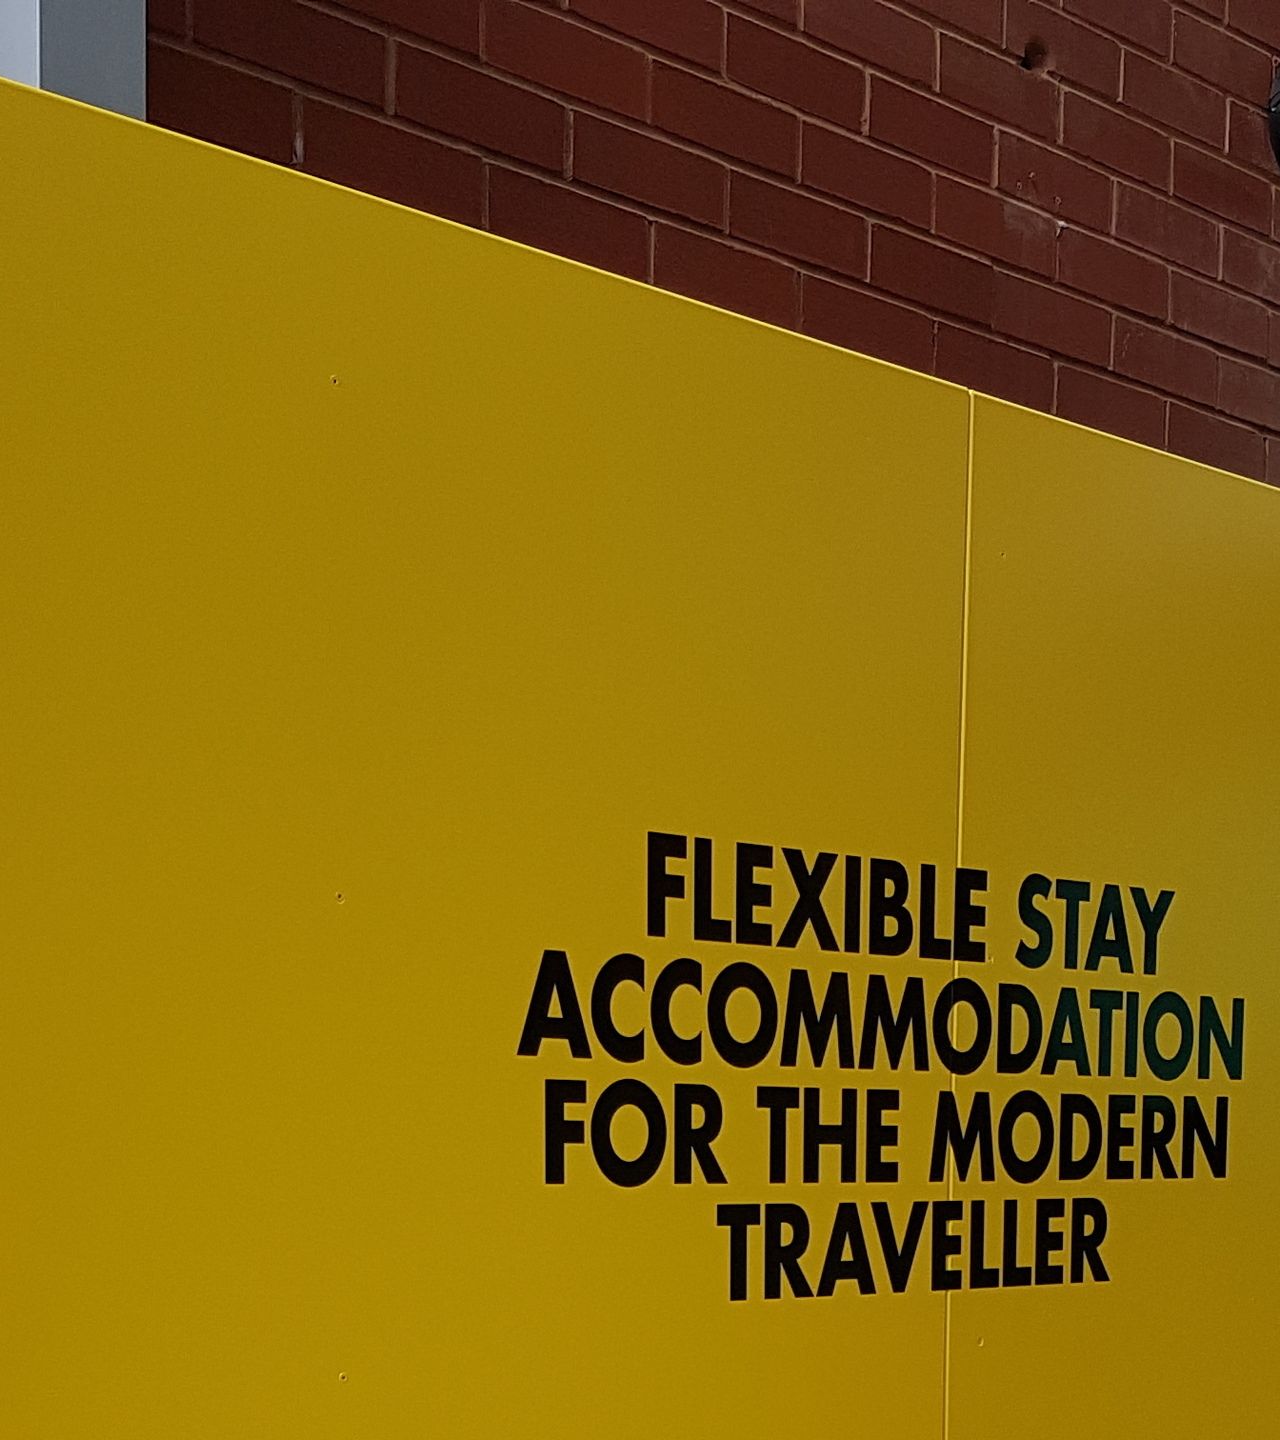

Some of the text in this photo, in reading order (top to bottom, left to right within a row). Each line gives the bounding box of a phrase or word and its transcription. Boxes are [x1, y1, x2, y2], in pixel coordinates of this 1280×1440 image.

[647, 831, 1175, 975] FLEXIBLE STAY
[516, 949, 1245, 1082] ACCOMMODATION
[544, 1078, 1229, 1188] FOR THE MODERN
[716, 1197, 1111, 1302] TRAVELLER
